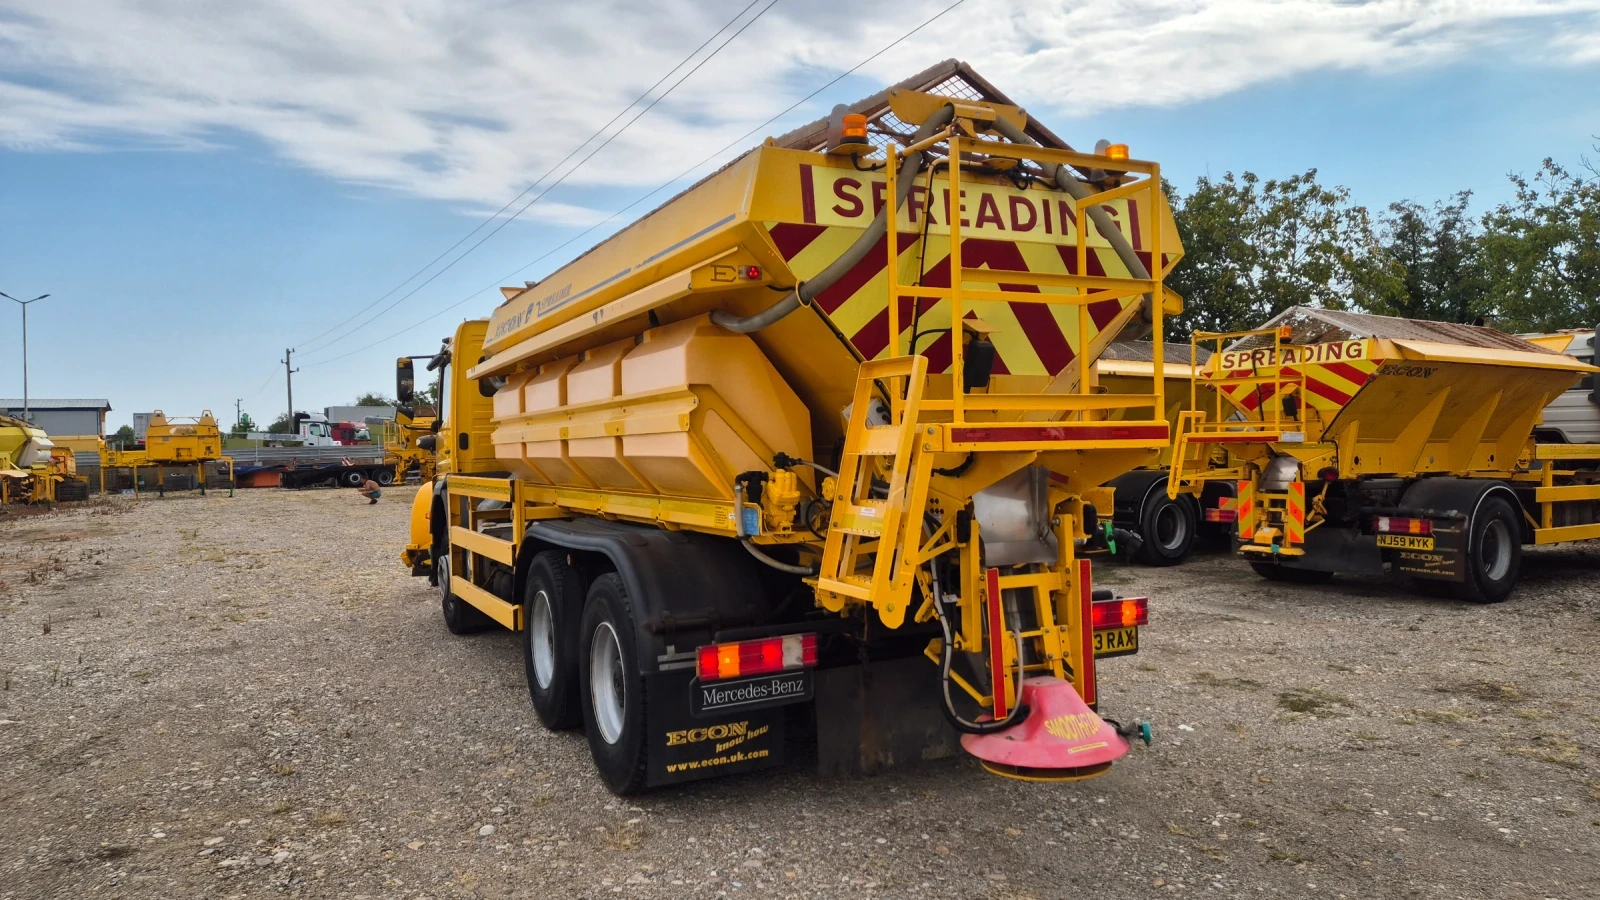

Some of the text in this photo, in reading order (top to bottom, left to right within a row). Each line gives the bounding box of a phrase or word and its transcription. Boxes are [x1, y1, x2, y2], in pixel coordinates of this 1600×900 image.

[1222, 341, 1362, 369] SPREADING
[1380, 365, 1438, 378] ECON
[1380, 536, 1429, 548] NJ59 MYK
[1400, 552, 1444, 561] ECON
[1107, 630, 1133, 649] RAX
[702, 679, 804, 706] Mercedes-Benz
[666, 721, 748, 746] ECON
[715, 725, 769, 753] know how
[666, 749, 769, 773] www.econ.uk.com
